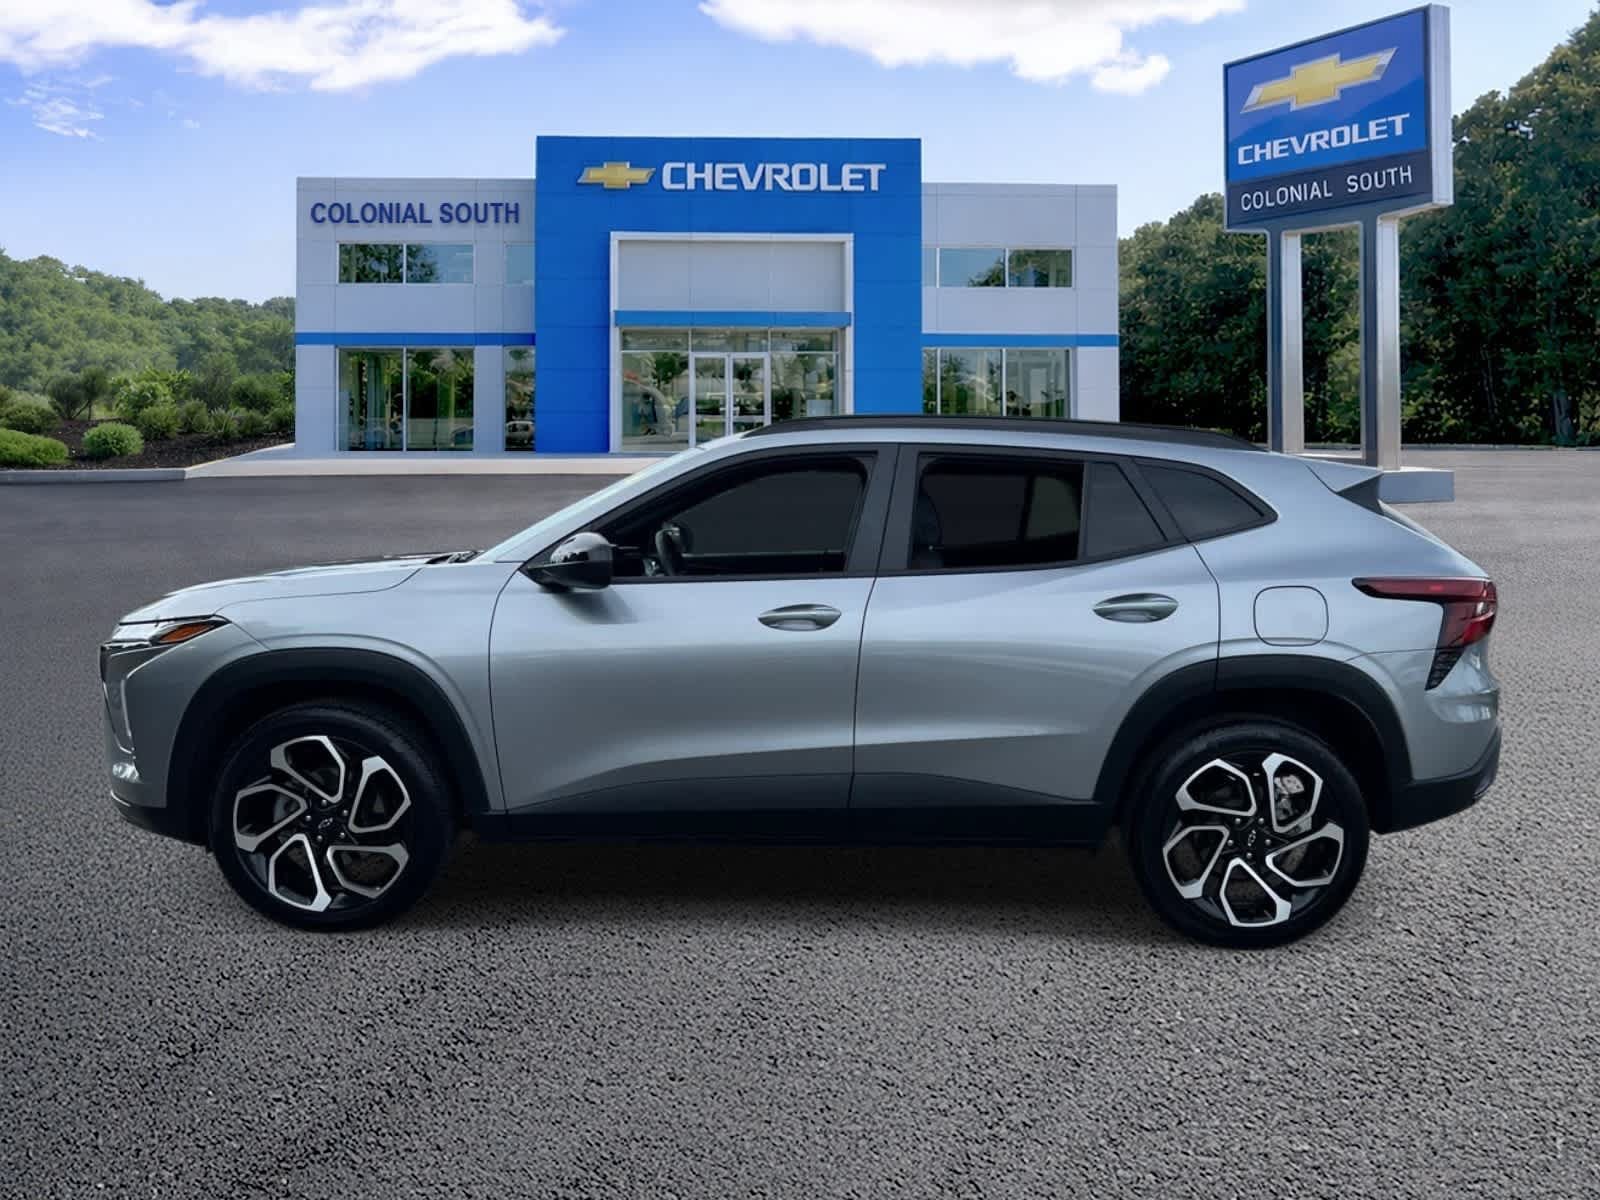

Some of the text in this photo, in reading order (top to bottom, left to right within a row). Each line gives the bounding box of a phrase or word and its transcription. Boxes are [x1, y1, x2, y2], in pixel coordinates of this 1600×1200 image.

[1238, 113, 1410, 165] CHEVROLET
[662, 162, 886, 192] CHEVROLET
[1241, 165, 1412, 211] COLONIAL SOUTH
[311, 202, 521, 225] COLONIAL SOUTH
